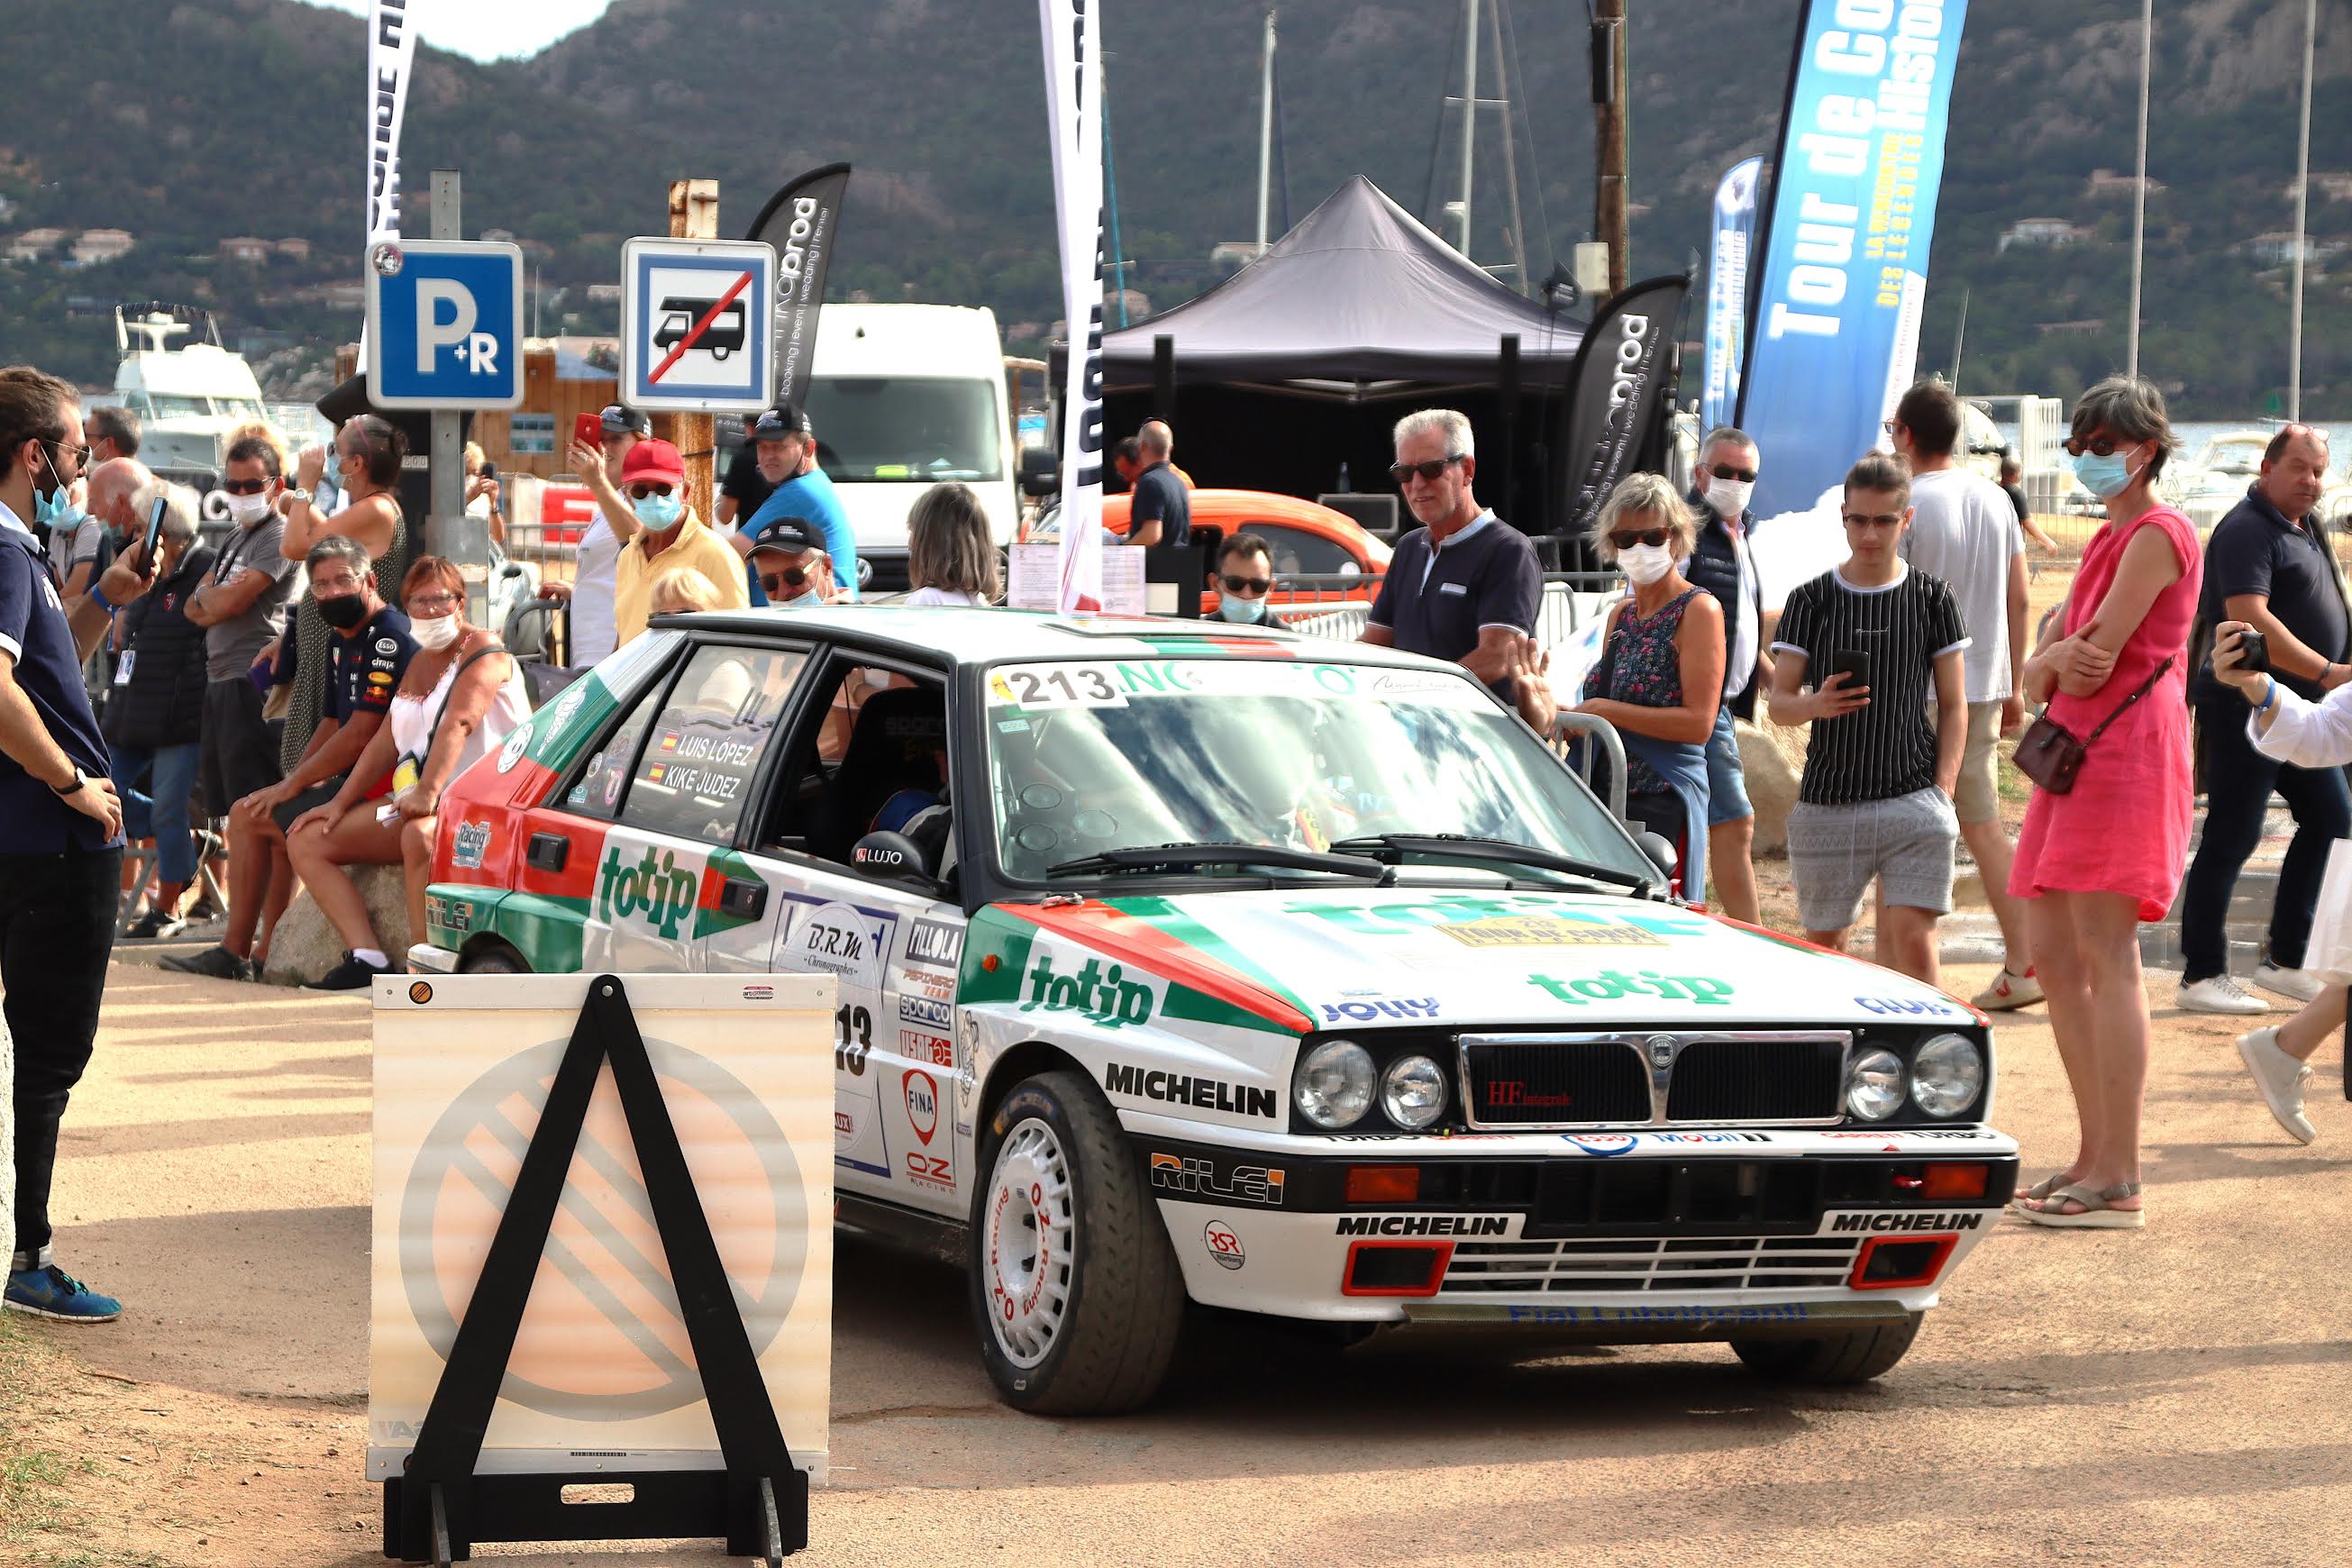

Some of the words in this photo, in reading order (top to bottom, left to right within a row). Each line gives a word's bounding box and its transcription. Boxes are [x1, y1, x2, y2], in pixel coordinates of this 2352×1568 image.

[1799, 94, 1877, 176] de
[1767, 192, 1859, 341] Tour
[1010, 670, 1116, 703] 213
[677, 737, 708, 761] LUIS
[707, 735, 754, 767] LÓPEZ
[664, 765, 696, 791] KIKE
[695, 774, 742, 799] JUDEZ
[458, 824, 486, 851] Racing
[867, 848, 902, 865] LUJO
[599, 846, 697, 941] totip
[1016, 956, 1153, 1032] totip
[1527, 970, 1736, 1006] totip
[900, 995, 950, 1023] sparco
[835, 1003, 872, 1077] 13
[900, 1030, 935, 1063] USAG
[907, 1089, 934, 1117] FINA
[1106, 1062, 1277, 1118] MICHELIN
[1487, 1080, 1526, 1107] HF
[1649, 1133, 1740, 1143] Mobil
[1150, 1152, 1285, 1206] RILEI
[1336, 1215, 1509, 1236] MICHELIN
[1831, 1212, 1983, 1233] MICHELIN
